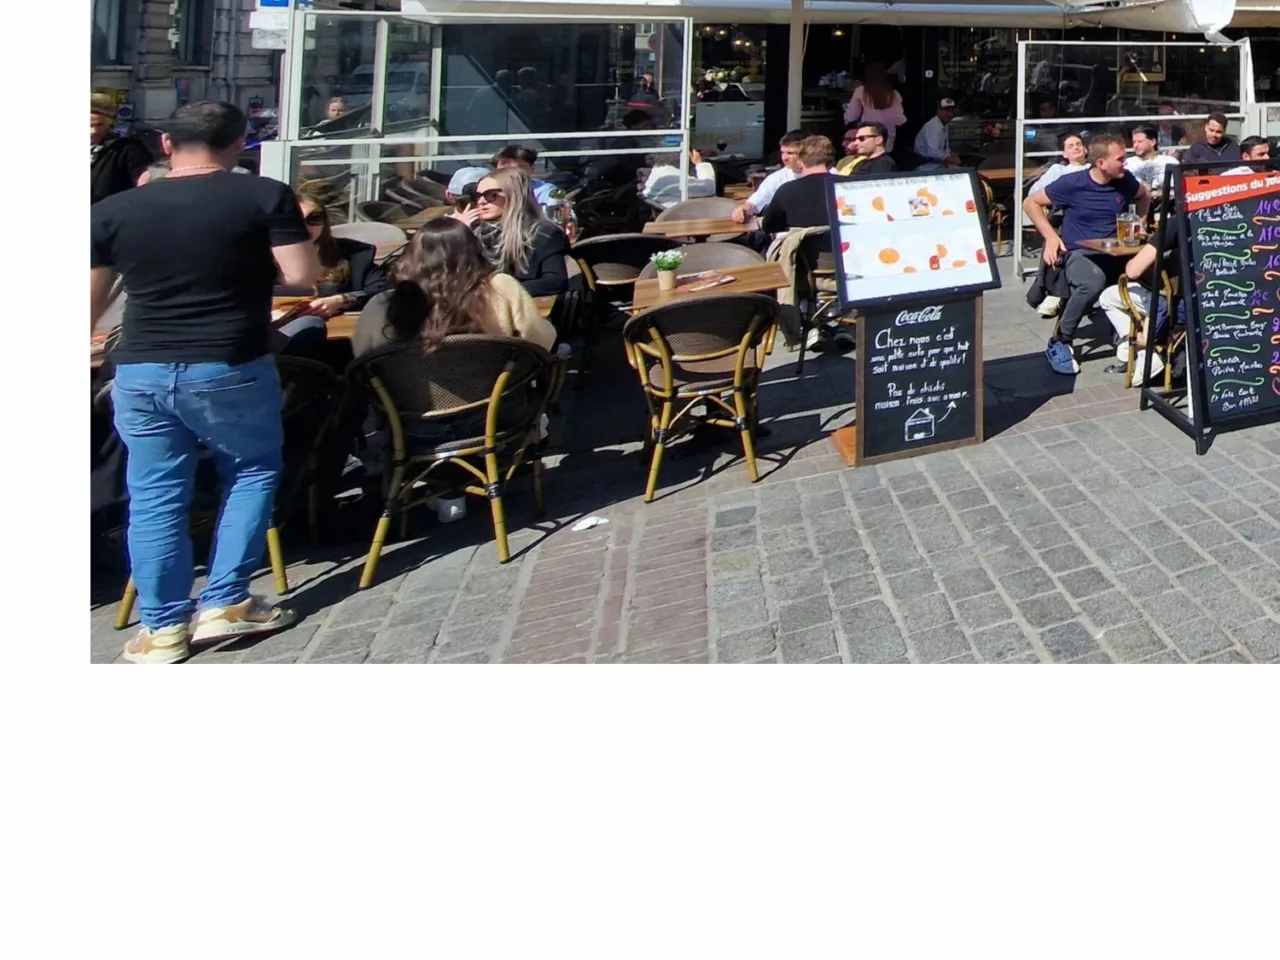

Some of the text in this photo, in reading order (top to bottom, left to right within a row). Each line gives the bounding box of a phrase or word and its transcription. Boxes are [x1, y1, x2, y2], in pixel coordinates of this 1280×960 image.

[1185, 183, 1249, 203] Suggestions
[1250, 179, 1265, 189] du
[875, 328, 906, 349] Chez
[909, 335, 931, 344] nous
[929, 357, 937, 367] de
[887, 382, 903, 397] Pas
[906, 382, 916, 396] de
